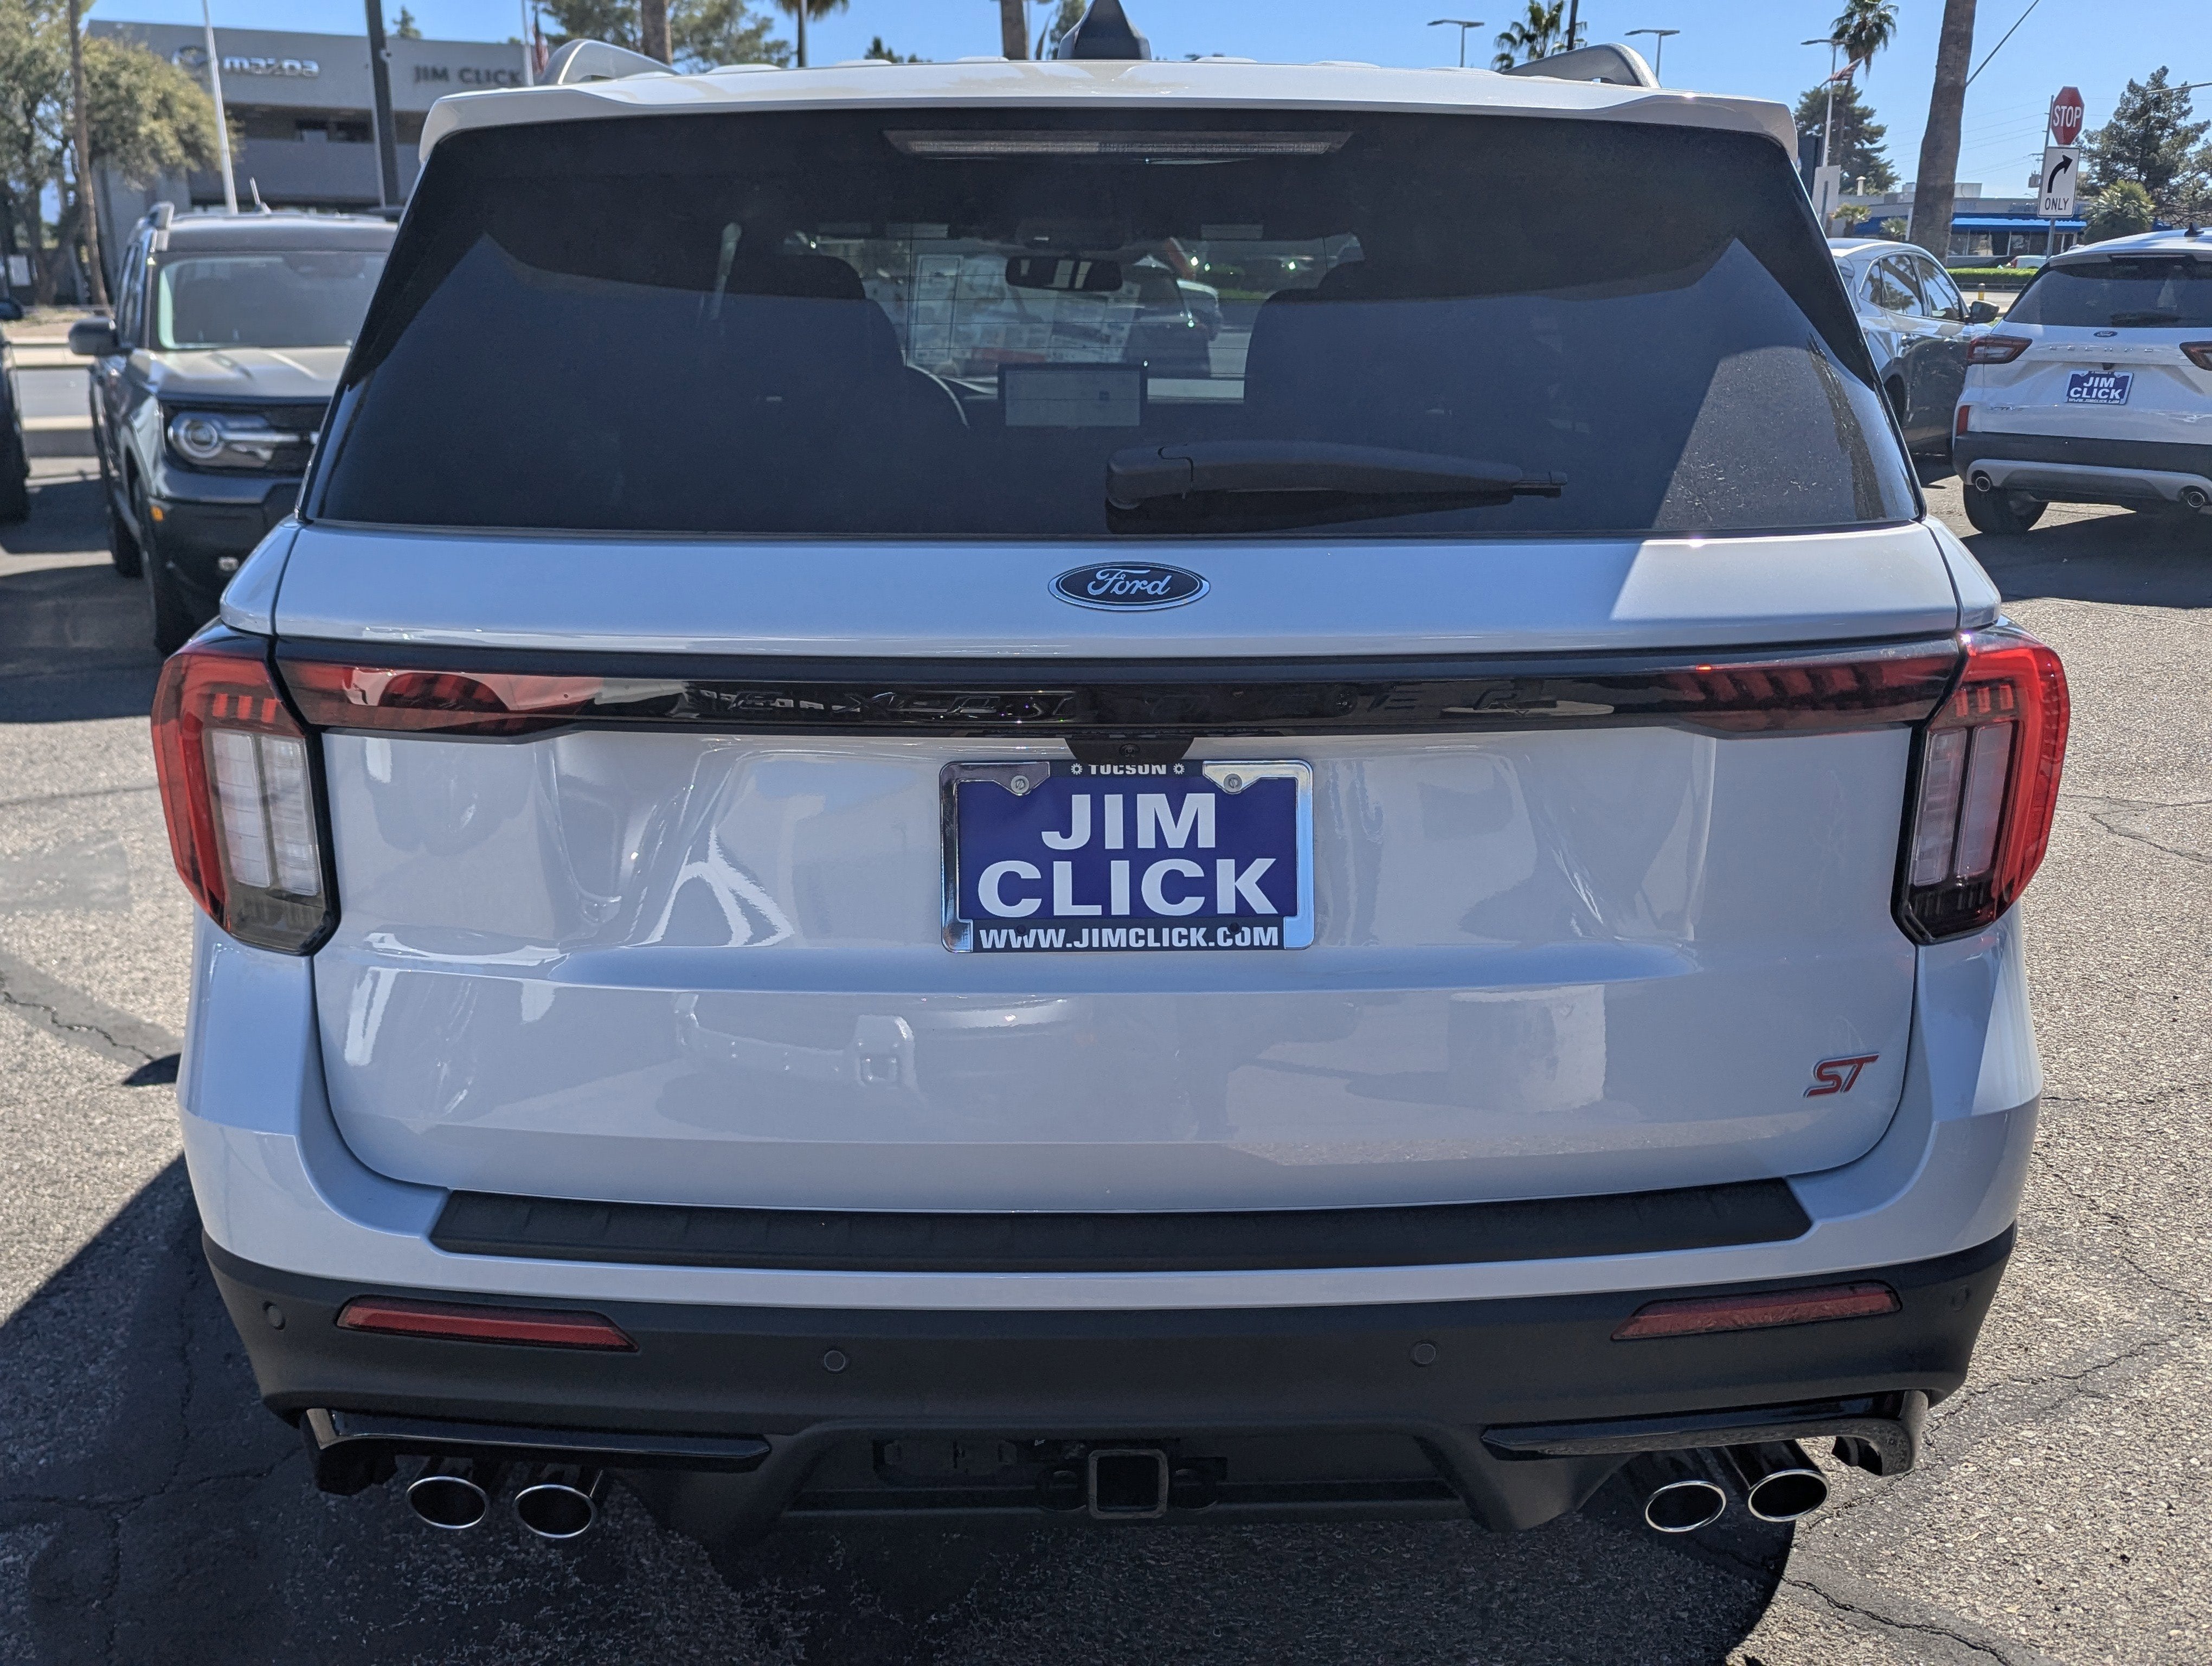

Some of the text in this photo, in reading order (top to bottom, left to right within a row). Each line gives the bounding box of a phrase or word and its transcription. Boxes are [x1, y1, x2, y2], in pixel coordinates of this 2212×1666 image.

[414, 65, 523, 86] JIM CLICK
[2053, 105, 2082, 127] STOP
[2044, 197, 2069, 210] ONLY
[2083, 377, 2115, 387] JIM
[2070, 387, 2123, 399] CLICK
[1087, 569, 1172, 595] Ford
[1088, 764, 1166, 775] TUCSON
[1041, 793, 1216, 850] JIM
[978, 858, 1278, 917] CLICK
[980, 927, 1278, 948] WWW.JIMCLICK.COM
[1803, 1052, 1880, 1098] ST
